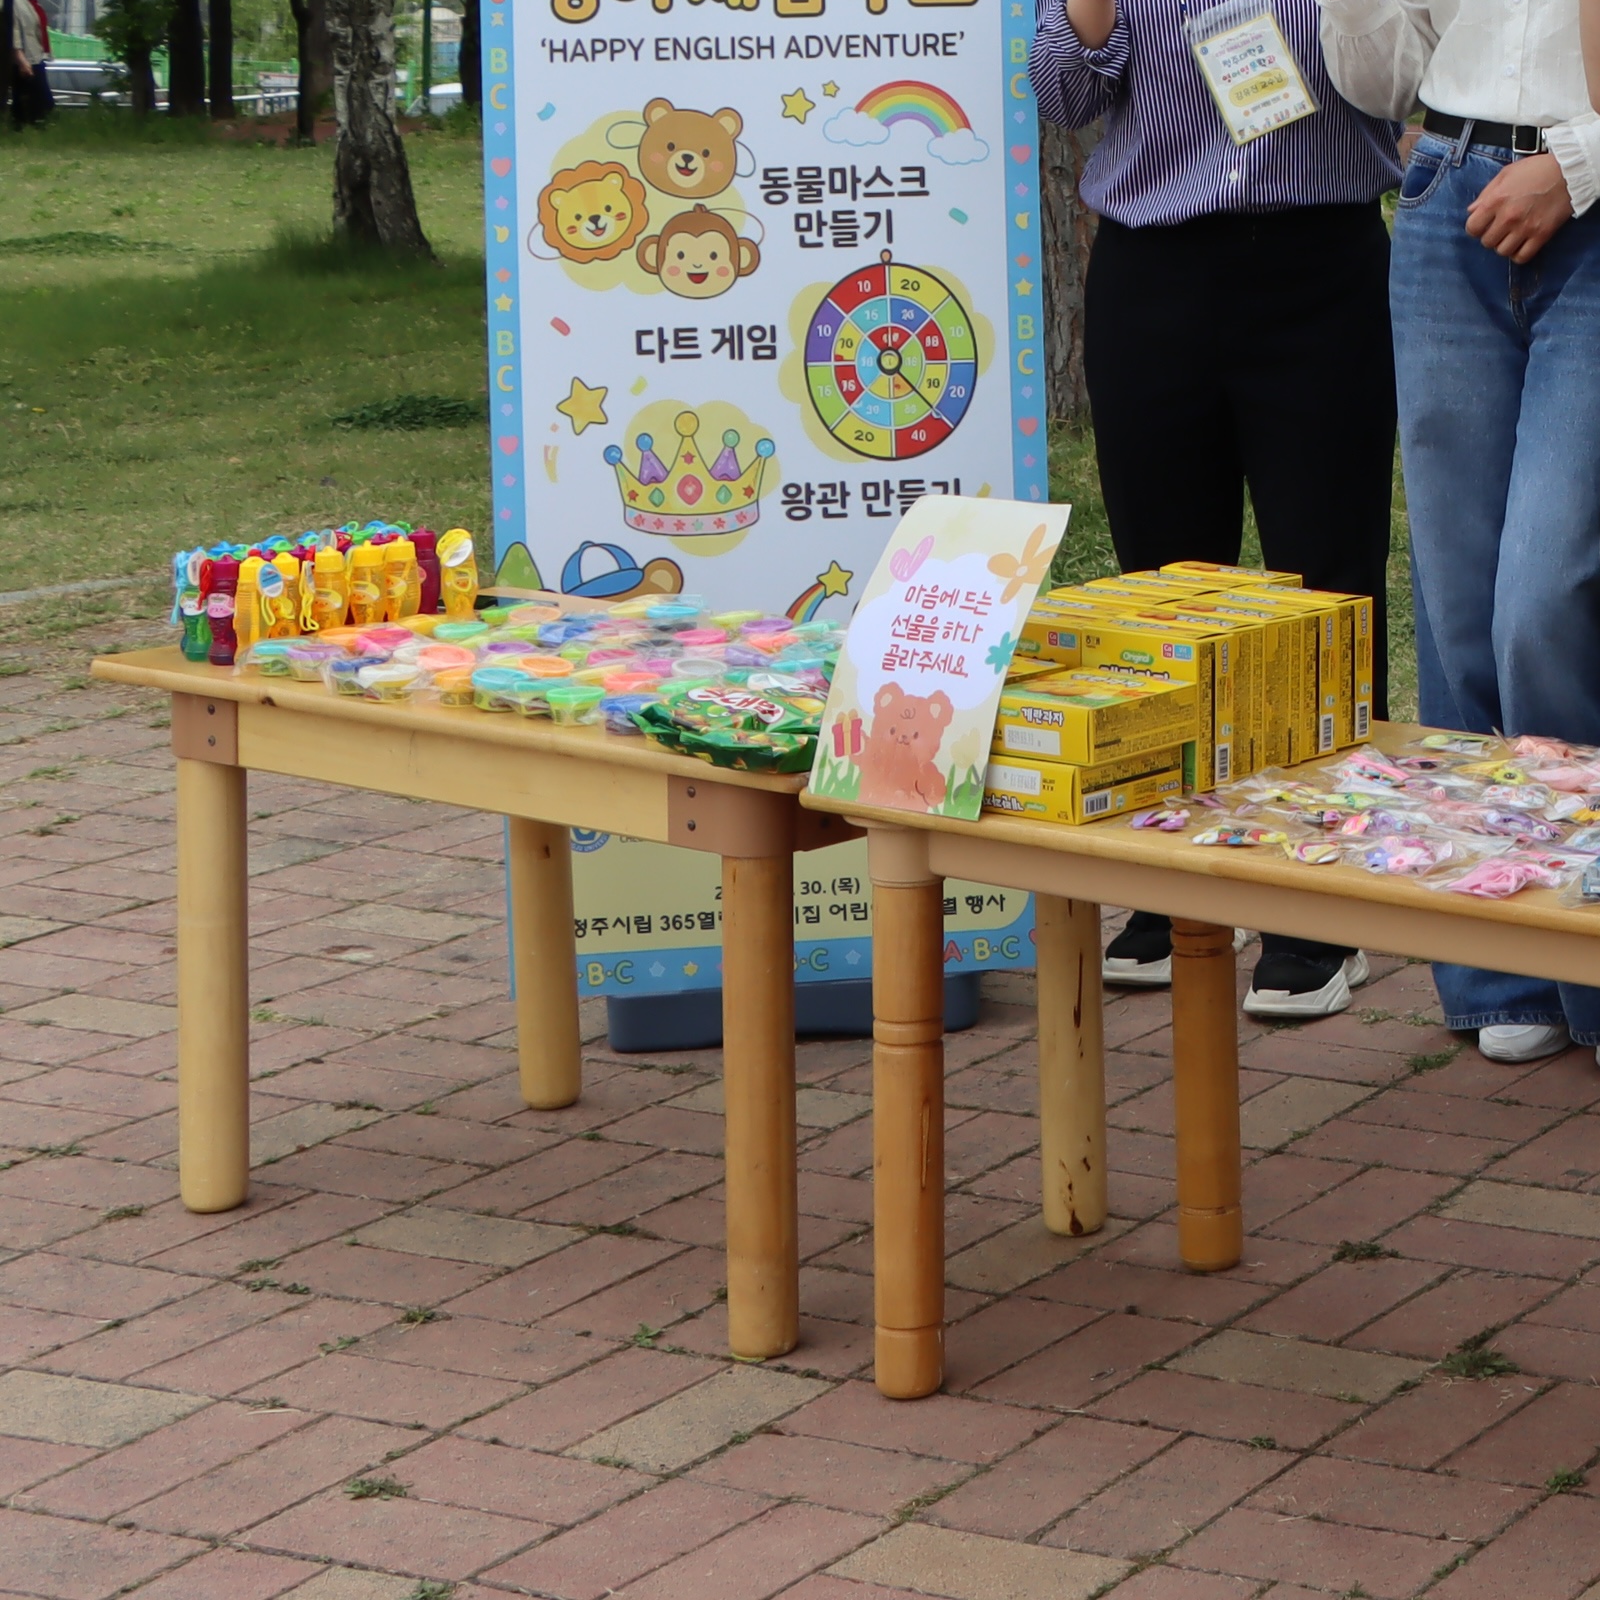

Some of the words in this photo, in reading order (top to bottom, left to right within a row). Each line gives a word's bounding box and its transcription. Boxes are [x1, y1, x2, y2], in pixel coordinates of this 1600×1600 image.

[654, 36, 775, 62] ENGLISH
[759, 164, 930, 205] 동물마스크
[794, 210, 894, 248] 만들기
[857, 280, 871, 293] 10
[900, 279, 920, 292] 20
[817, 325, 831, 337] 10
[636, 327, 702, 363] 다트
[711, 325, 778, 361] 게임
[854, 430, 874, 442] 20
[911, 430, 926, 441] 40
[781, 481, 851, 521] 왕관
[904, 584, 960, 609] 마음에
[959, 590, 992, 616] 드는
[891, 614, 939, 643] 선물을
[942, 621, 983, 643] 하나
[1021, 707, 1064, 727] 계란과자
[832, 877, 861, 896] (목)
[965, 894, 1006, 914] 행사
